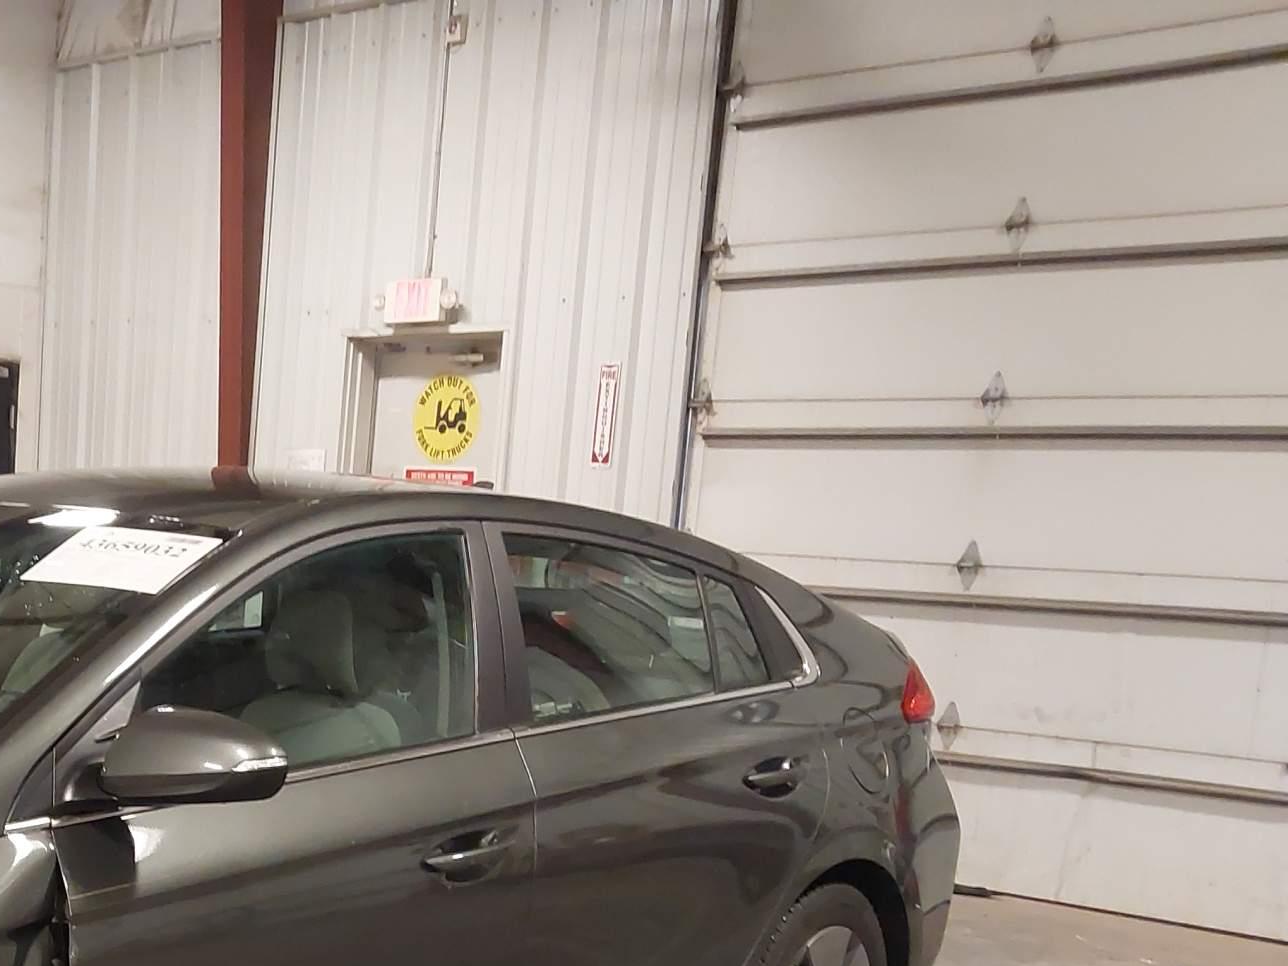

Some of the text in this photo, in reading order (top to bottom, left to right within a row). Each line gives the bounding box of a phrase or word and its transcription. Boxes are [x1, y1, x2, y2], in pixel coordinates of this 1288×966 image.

[601, 370, 616, 380] FIRE
[419, 376, 476, 407] WATCH OUT FOR
[416, 428, 472, 460] FORK LIFT TRUCKS
